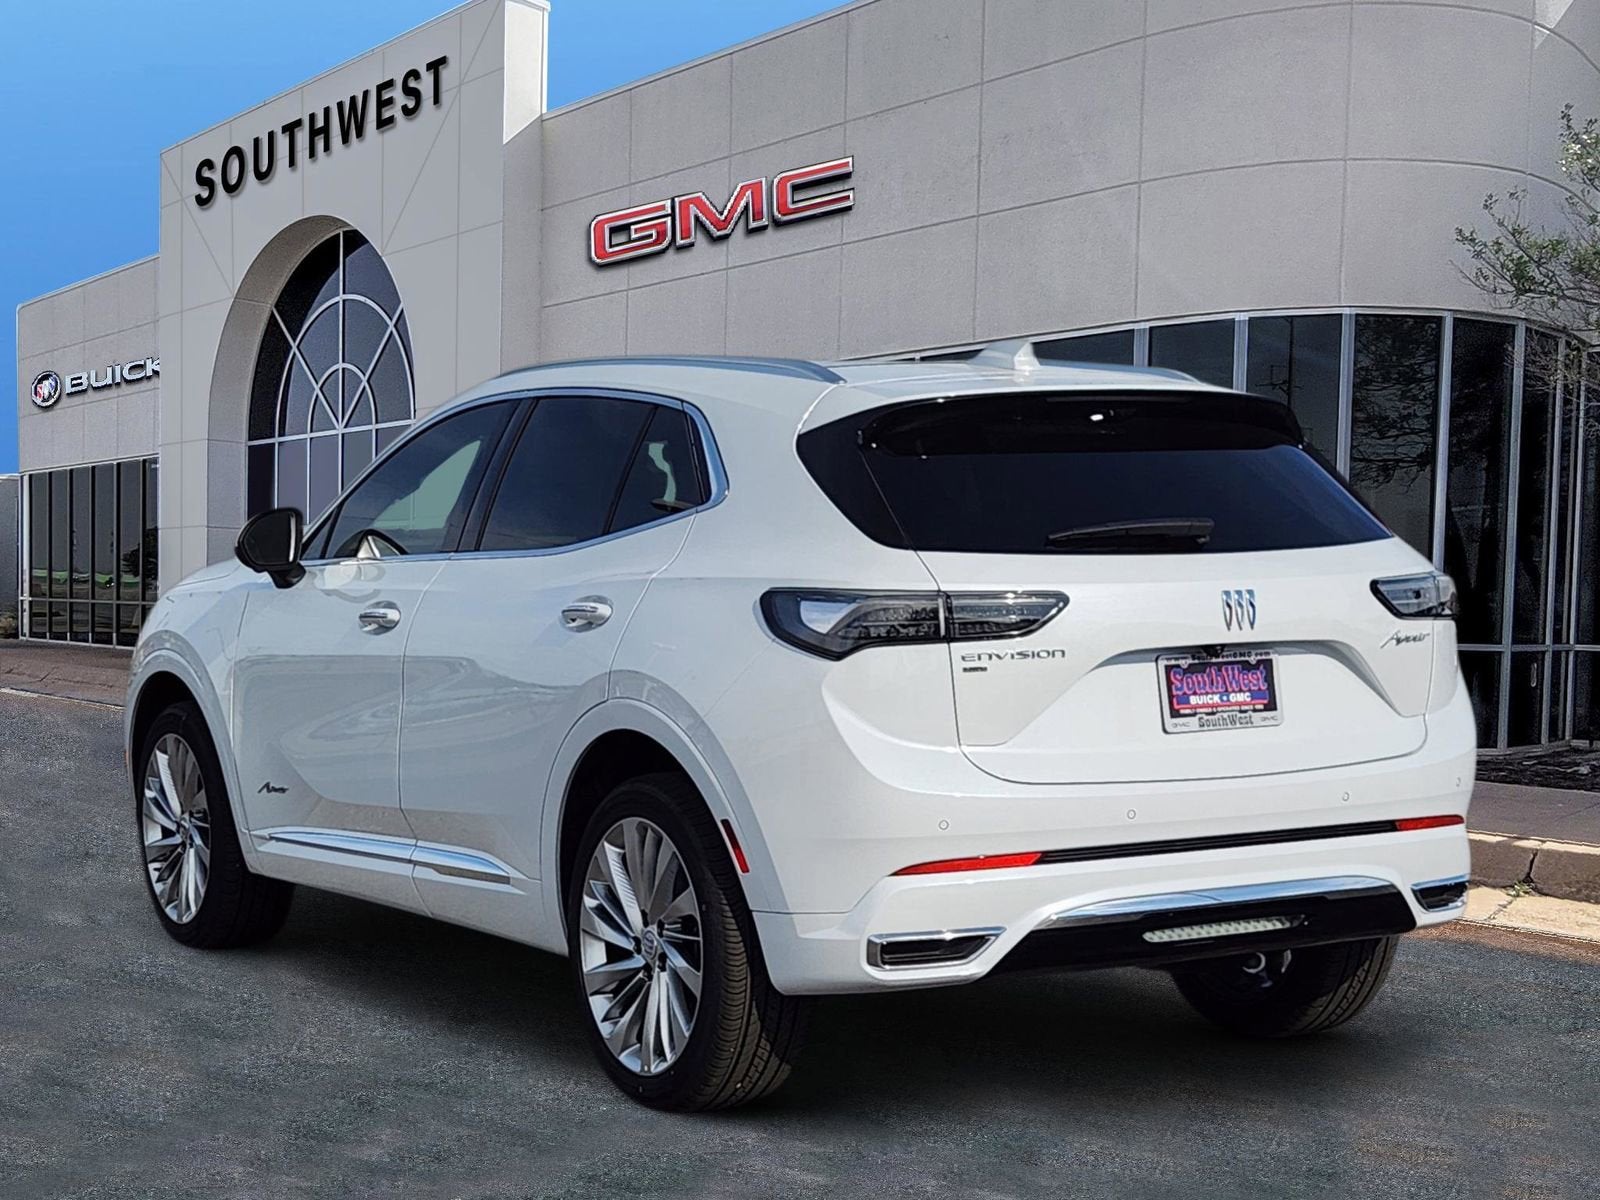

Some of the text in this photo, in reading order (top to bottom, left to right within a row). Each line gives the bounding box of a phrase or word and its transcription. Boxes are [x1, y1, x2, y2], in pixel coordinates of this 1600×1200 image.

[194, 55, 448, 208] SOUTHWEST
[589, 155, 855, 266] GMC
[65, 357, 160, 395] BUICK
[961, 649, 1066, 662] ENVISION
[1170, 664, 1268, 695] SouthWest
[1189, 692, 1252, 705] BUICK GMC
[1198, 713, 1254, 729] SouthWest
